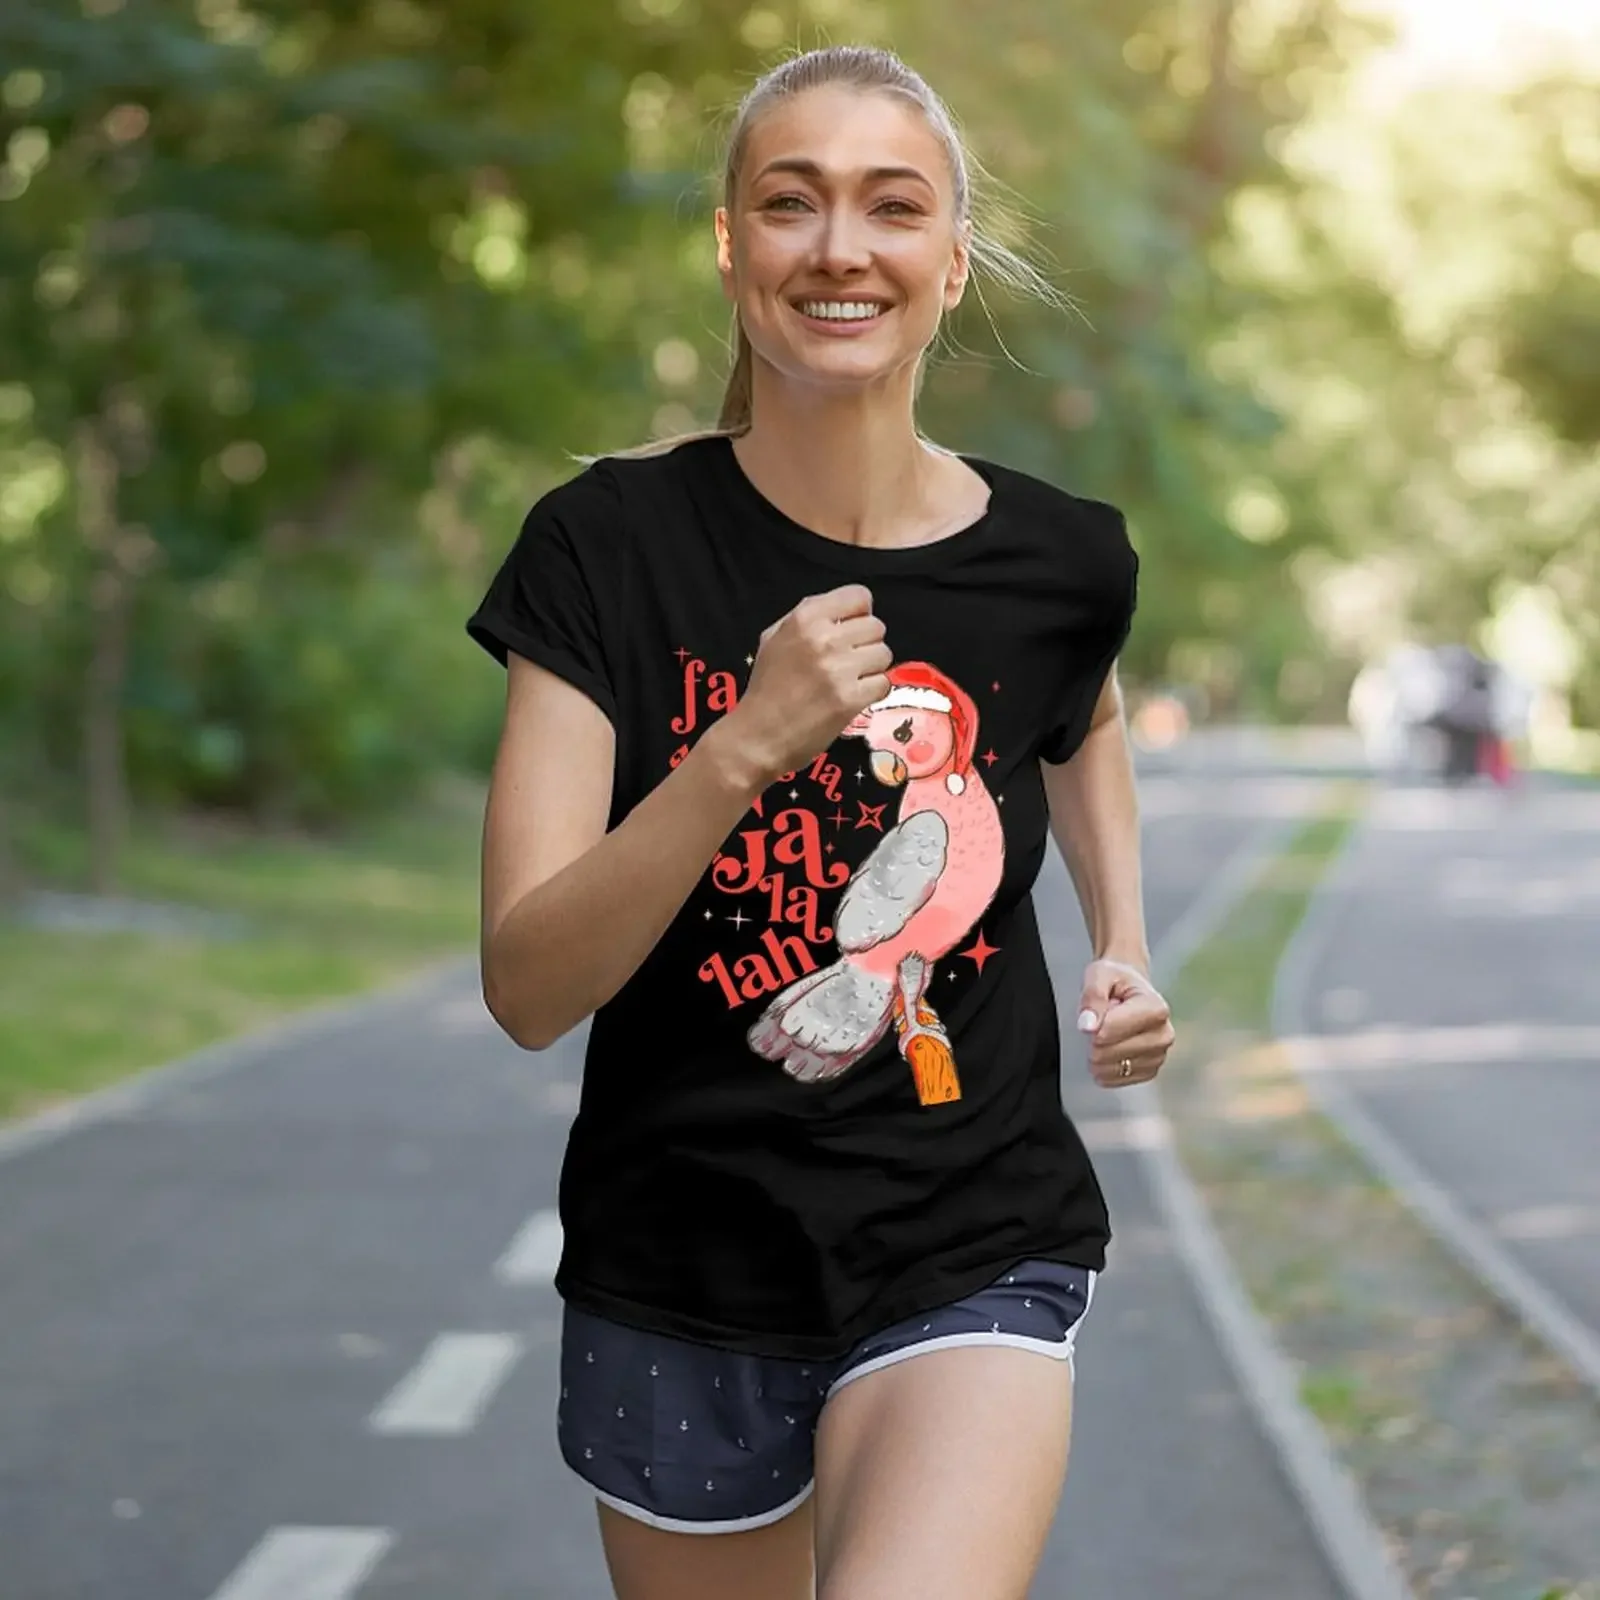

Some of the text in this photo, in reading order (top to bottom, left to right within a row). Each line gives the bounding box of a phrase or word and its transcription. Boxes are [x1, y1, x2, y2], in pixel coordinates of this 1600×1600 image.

[670, 658, 739, 735] fa
[757, 871, 835, 944] la
[697, 927, 820, 1010] lah
